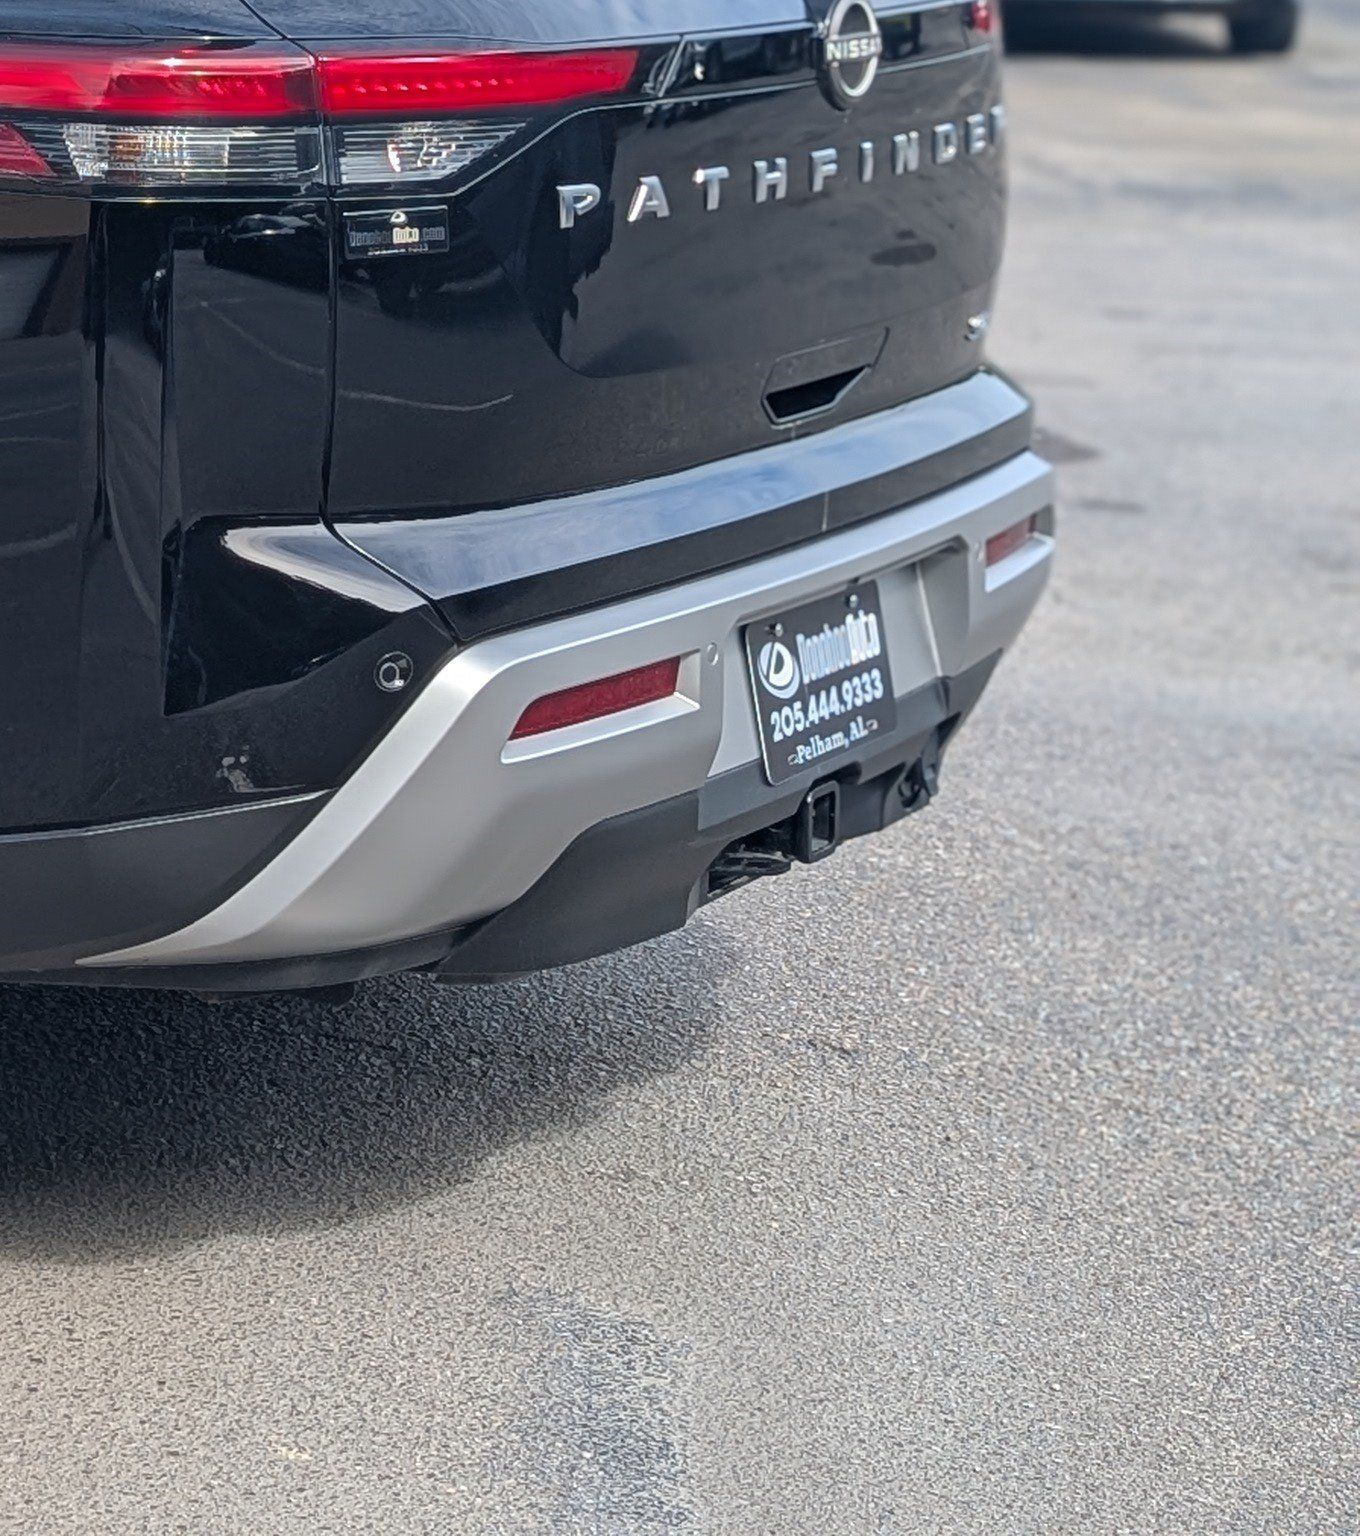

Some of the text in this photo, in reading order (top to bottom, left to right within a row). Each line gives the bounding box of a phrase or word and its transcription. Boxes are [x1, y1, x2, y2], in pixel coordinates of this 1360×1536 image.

[770, 667, 884, 742] 205.444.9333
[796, 715, 870, 765] Pelham, AL
